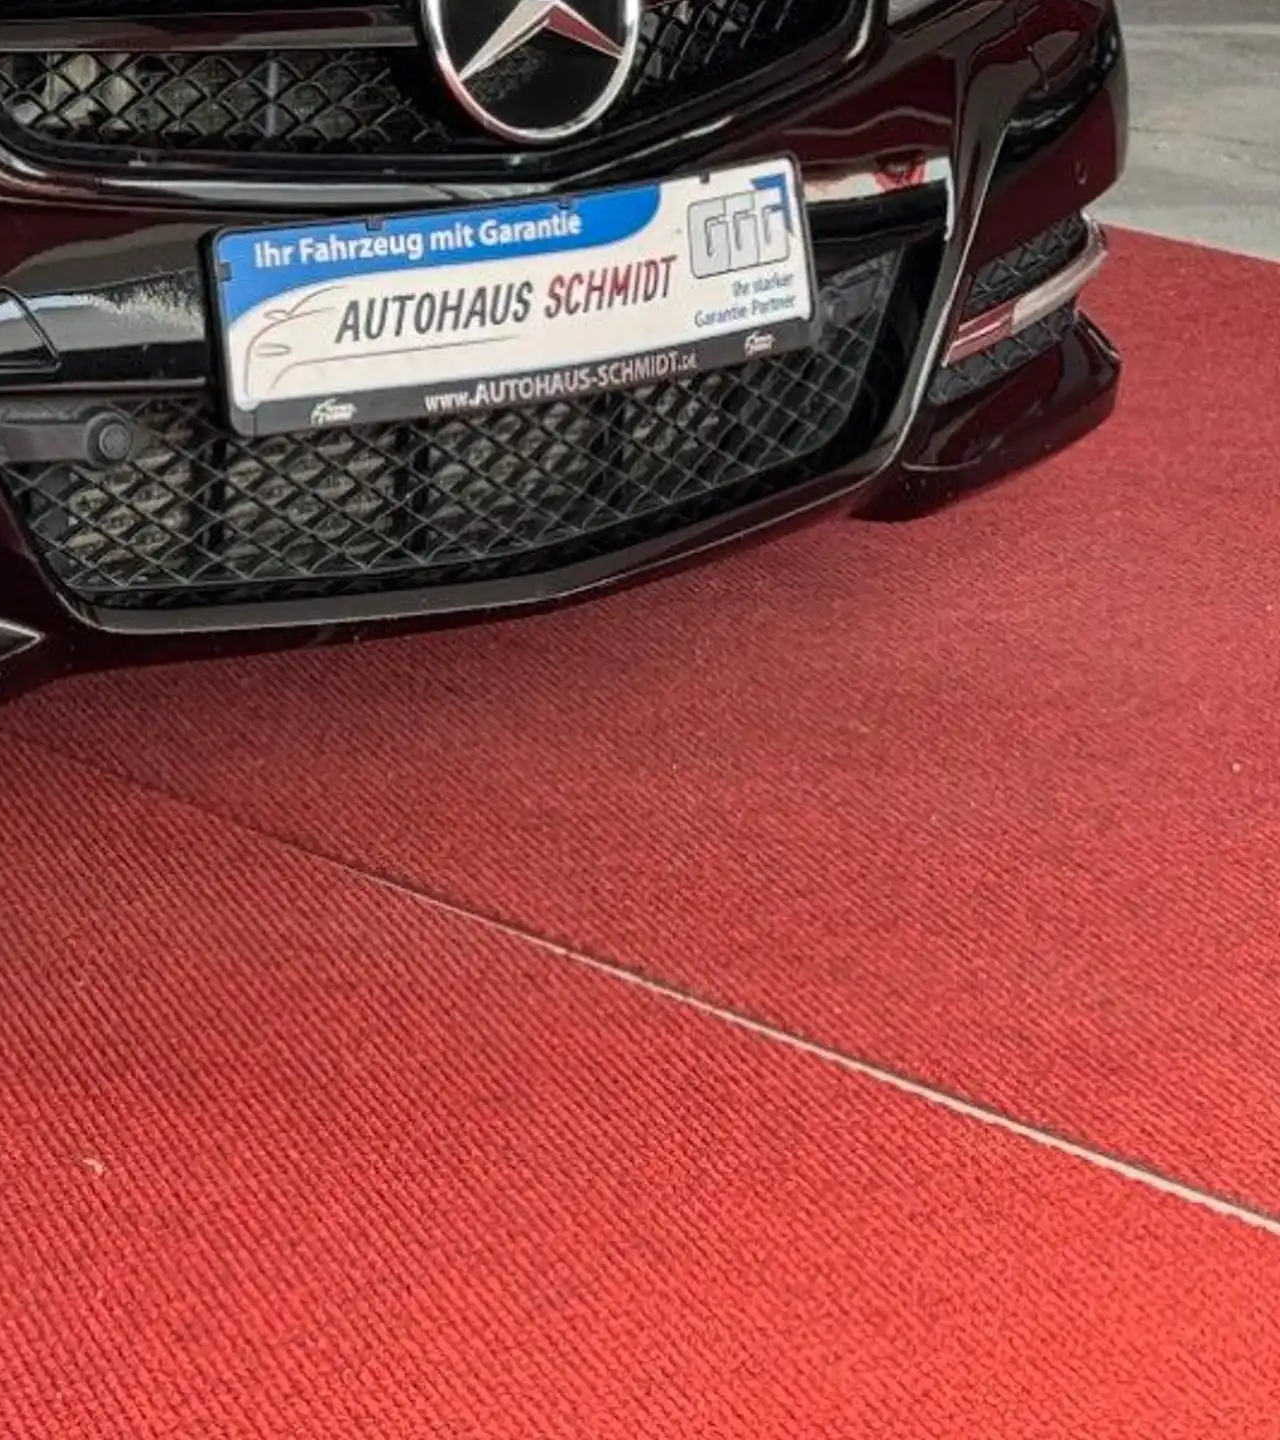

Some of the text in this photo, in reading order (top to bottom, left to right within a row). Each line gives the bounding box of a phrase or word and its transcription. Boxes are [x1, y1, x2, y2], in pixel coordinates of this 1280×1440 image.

[254, 211, 583, 269] Ihr Fahrzeug mit Garantie
[334, 254, 678, 344] AUTOHAUS SCHMIDT
